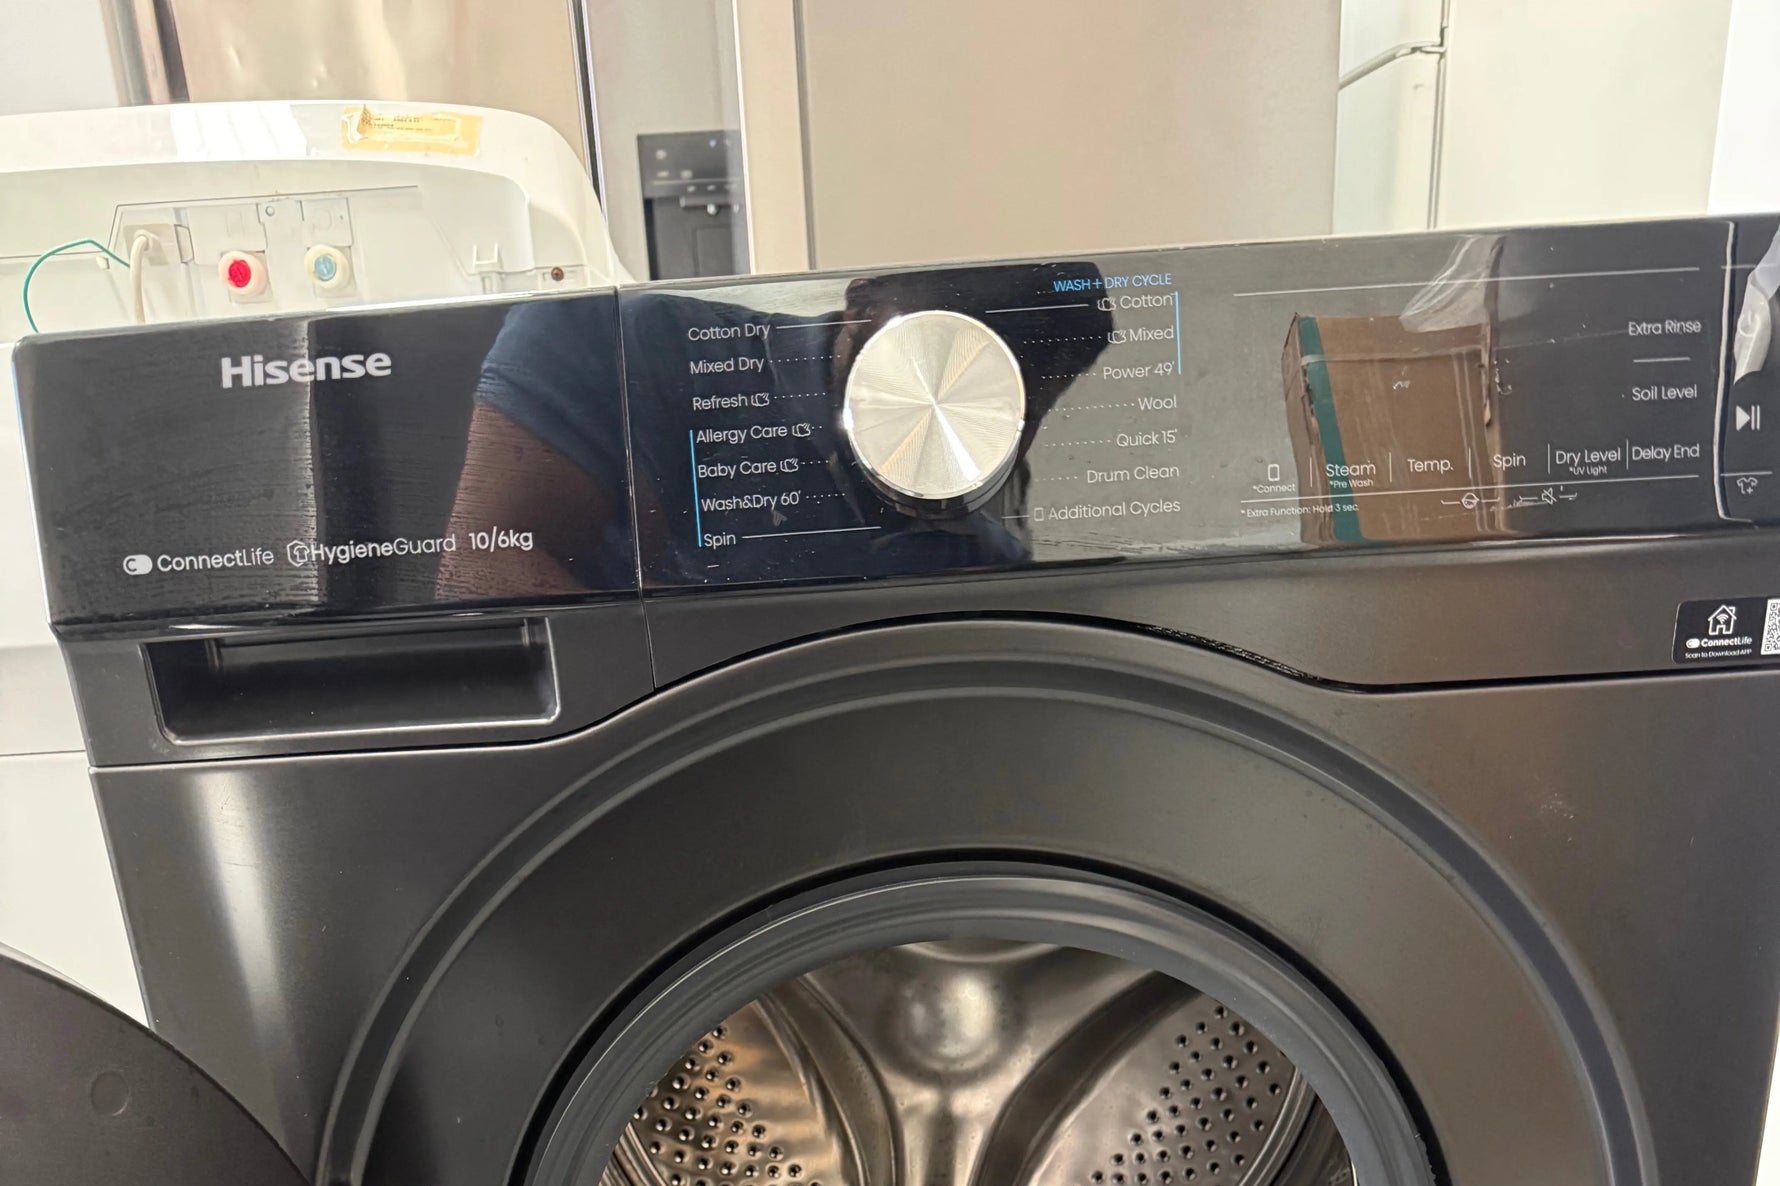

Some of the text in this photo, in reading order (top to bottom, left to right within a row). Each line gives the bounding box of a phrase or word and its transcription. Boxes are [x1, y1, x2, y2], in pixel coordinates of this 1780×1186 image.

[1054, 279, 1091, 292] WASH
[1104, 276, 1129, 289] DRY
[1132, 273, 1172, 287] CYCLE
[1120, 294, 1173, 309] Cotton
[688, 323, 770, 341] Cotton Dry
[1129, 326, 1174, 342] Mixed
[1628, 320, 1701, 336] Extra Rinse
[221, 351, 392, 389] Hisense
[690, 357, 764, 374] Mixed Dry
[1103, 366, 1149, 379] Power
[1632, 385, 1697, 400] Soil Level
[693, 394, 748, 410] Refresh
[1138, 395, 1177, 410] Wool
[696, 425, 787, 444] Allergy Care
[1116, 432, 1159, 447] Quick
[1493, 453, 1526, 469] Spin
[1556, 450, 1621, 466] Dry Level
[1632, 444, 1700, 462] Delay End
[698, 461, 777, 479] Baby Care
[1326, 462, 1376, 477] Steam
[1407, 458, 1454, 474] Temp.
[1586, 465, 1608, 476] Light
[1087, 466, 1179, 483] Drum Clean
[1349, 478, 1374, 488] Wash
[701, 495, 777, 512] Wash&Dry
[1048, 499, 1181, 520] Additional Cycles
[1247, 508, 1268, 518] Extra
[1270, 506, 1311, 516] Function:
[1313, 504, 1333, 513] Hold
[1335, 504, 1341, 512] 3
[703, 532, 736, 549] Spin
[157, 529, 534, 573] ConnectLife HygieneGuard 10/6kg
[1701, 636, 1752, 647] ConnectLife
